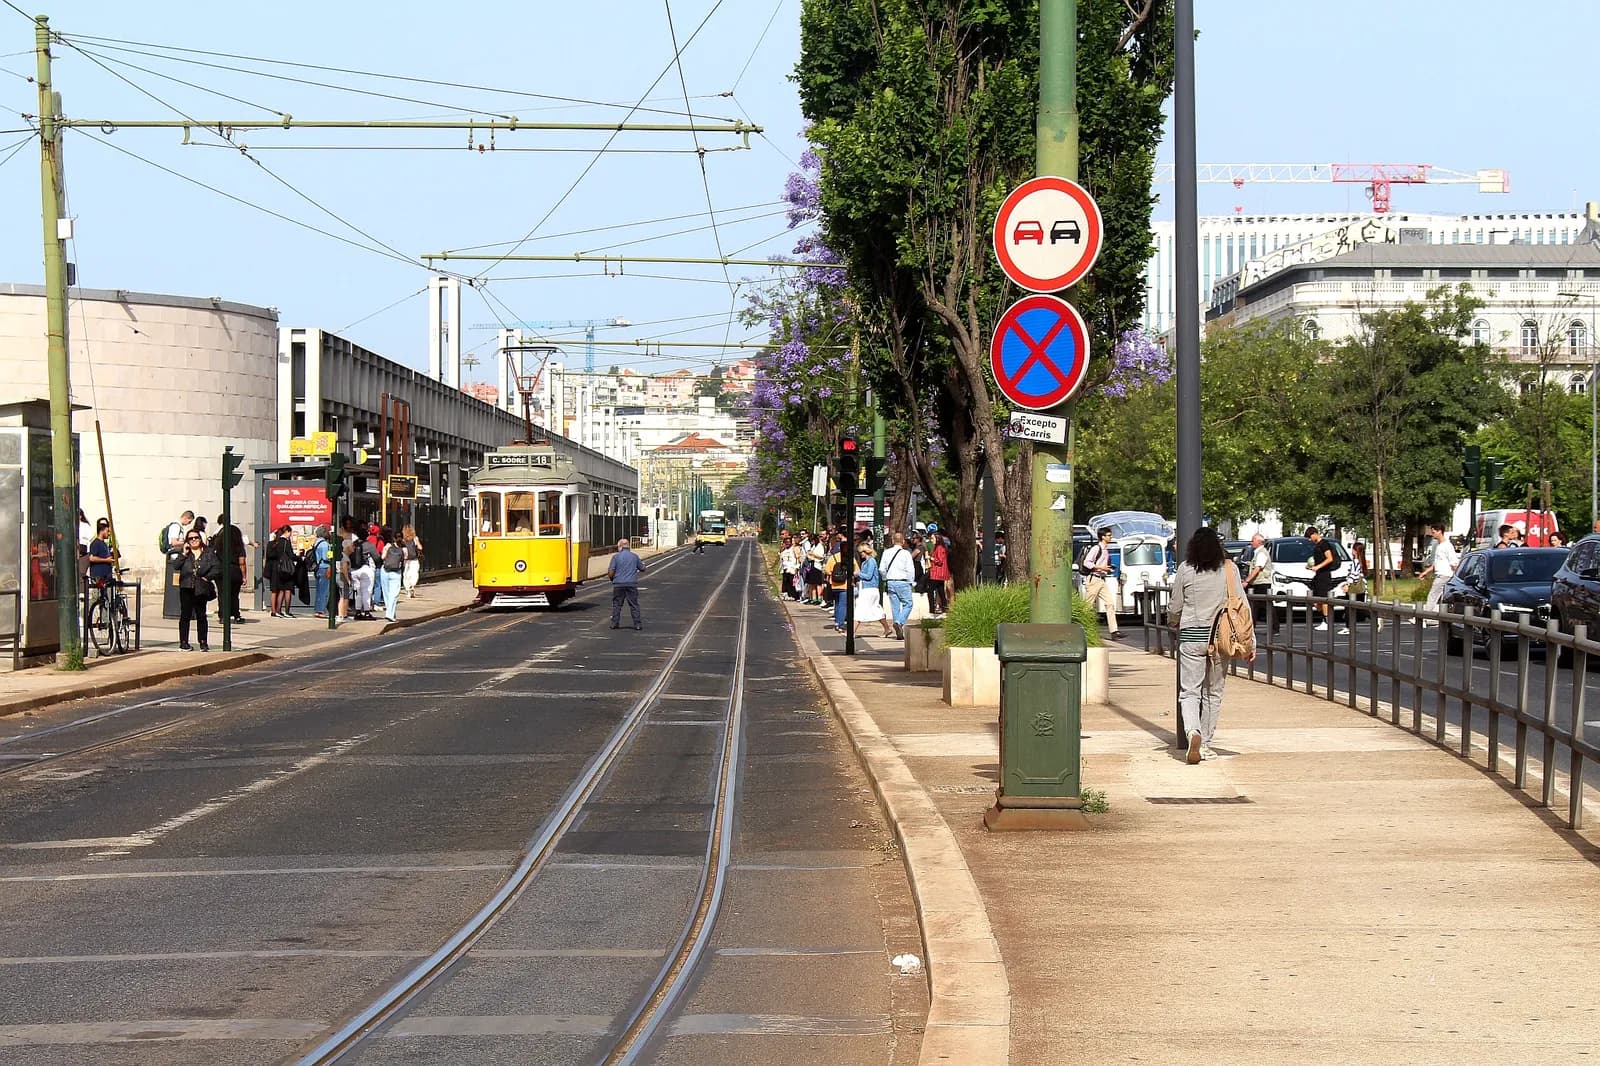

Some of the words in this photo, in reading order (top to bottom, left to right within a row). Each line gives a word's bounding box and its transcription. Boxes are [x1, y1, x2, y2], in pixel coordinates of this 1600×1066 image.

[1020, 415, 1057, 429] Excepto
[1023, 427, 1051, 439] Carris
[536, 456, 547, 464] 18
